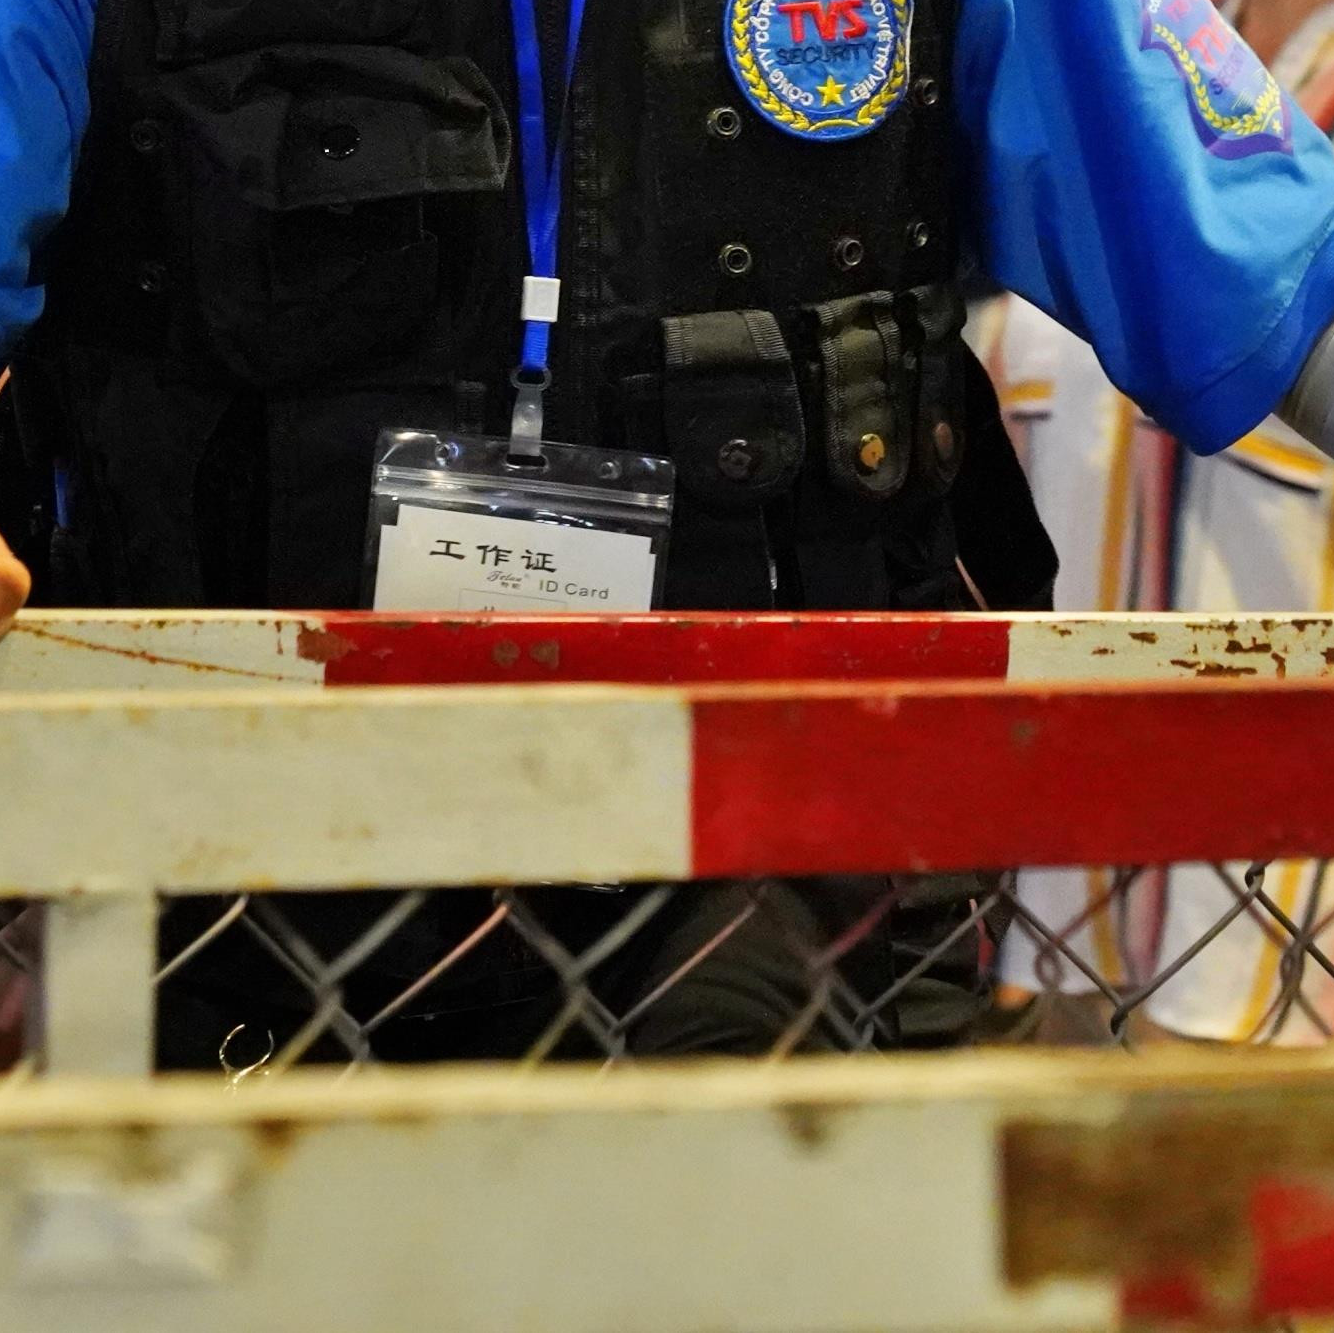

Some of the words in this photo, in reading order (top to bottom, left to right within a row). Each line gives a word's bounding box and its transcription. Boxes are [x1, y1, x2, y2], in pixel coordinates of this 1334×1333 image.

[756, 49, 775, 72] TY
[775, 41, 879, 66] SECURITY
[769, 69, 815, 107] CÔNG
[429, 538, 558, 573] 工作证
[539, 579, 559, 593] ID
[564, 583, 609, 600] Card
